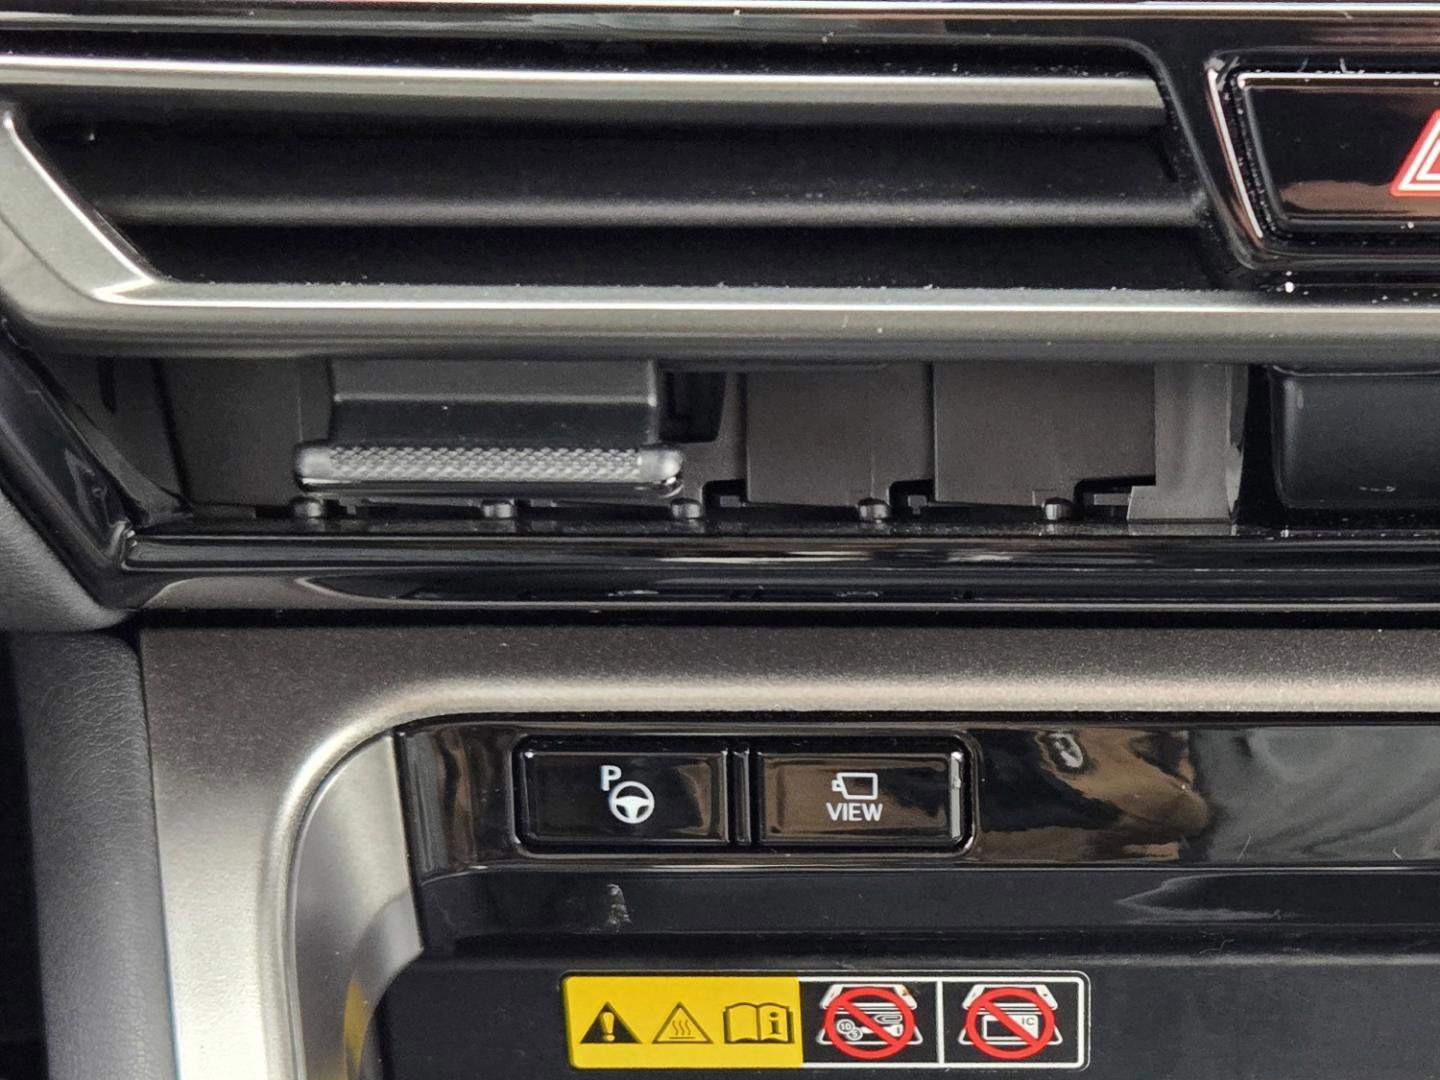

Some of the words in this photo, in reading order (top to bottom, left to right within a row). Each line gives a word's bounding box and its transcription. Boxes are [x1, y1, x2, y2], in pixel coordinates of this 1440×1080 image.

[600, 764, 622, 792] P
[825, 802, 883, 821] VIEW
[840, 1022, 851, 1031] 10
[1021, 1017, 1035, 1026] IC
